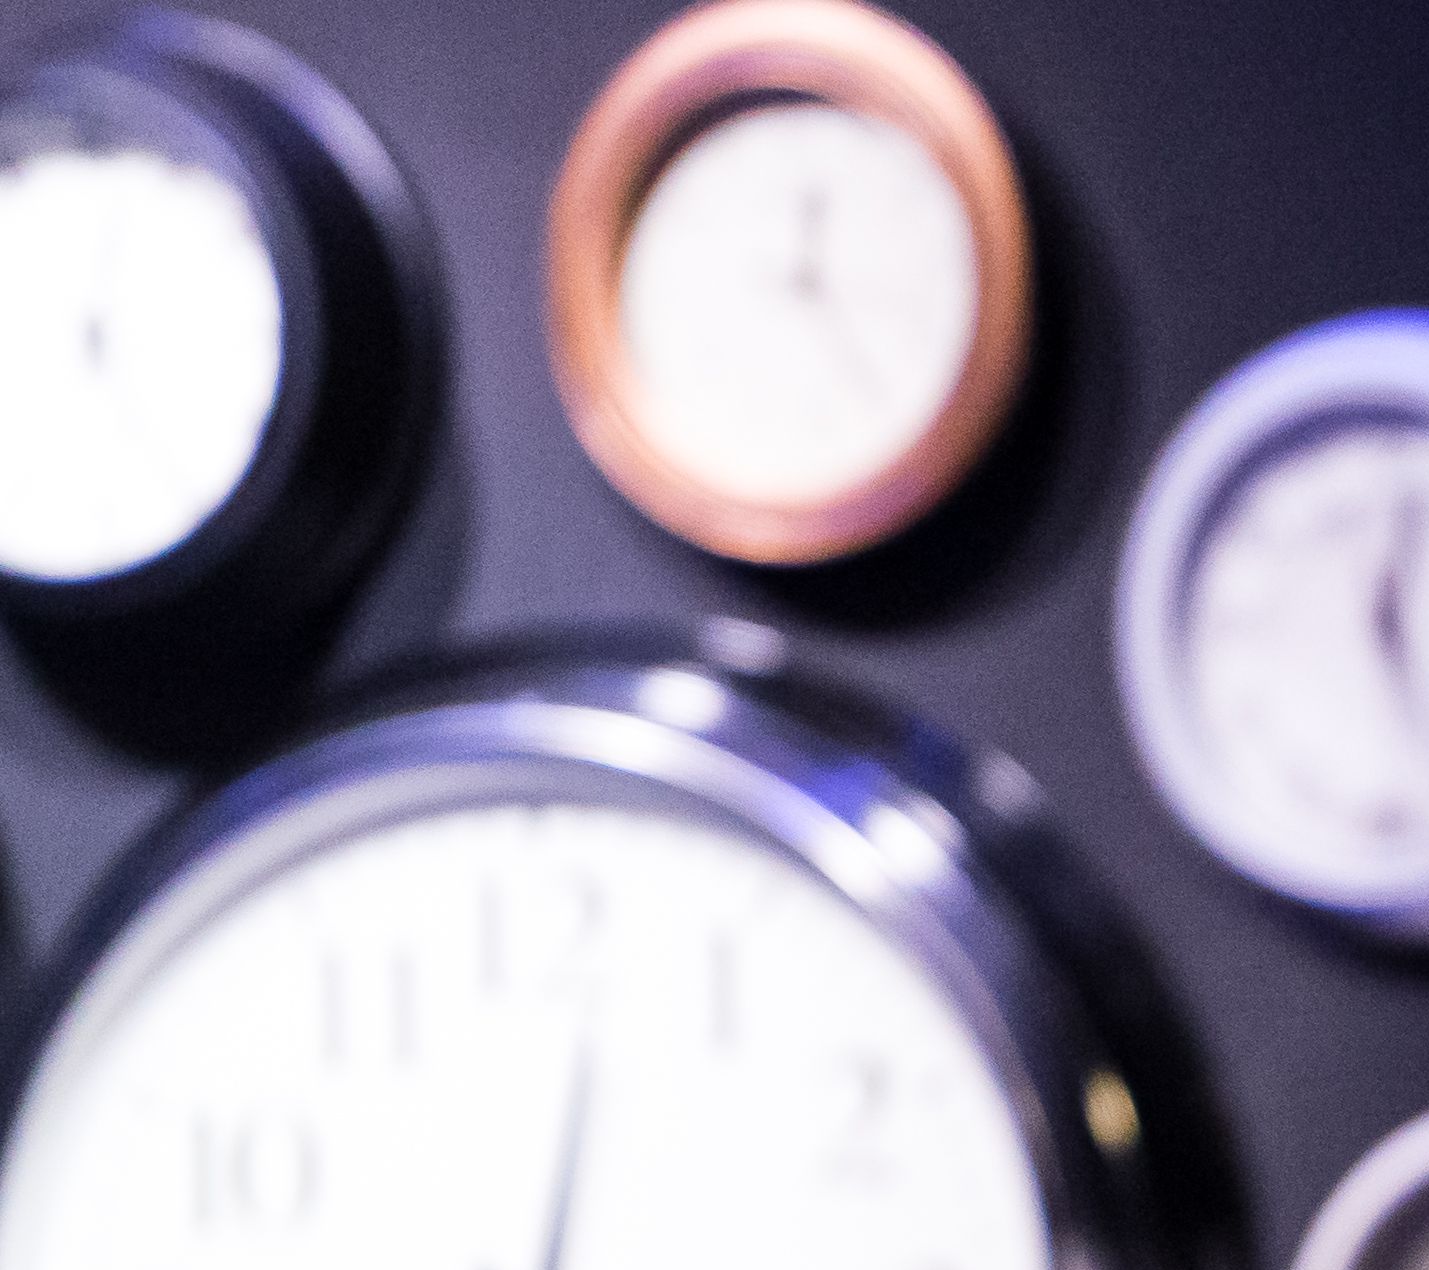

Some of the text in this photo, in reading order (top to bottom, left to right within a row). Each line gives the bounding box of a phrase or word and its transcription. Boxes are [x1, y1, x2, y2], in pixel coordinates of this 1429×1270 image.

[476, 866, 612, 1002] 12
[704, 923, 748, 1064] 1
[315, 945, 425, 1070] 11
[187, 1098, 325, 1234] 10
[821, 1042, 902, 1195] 2
